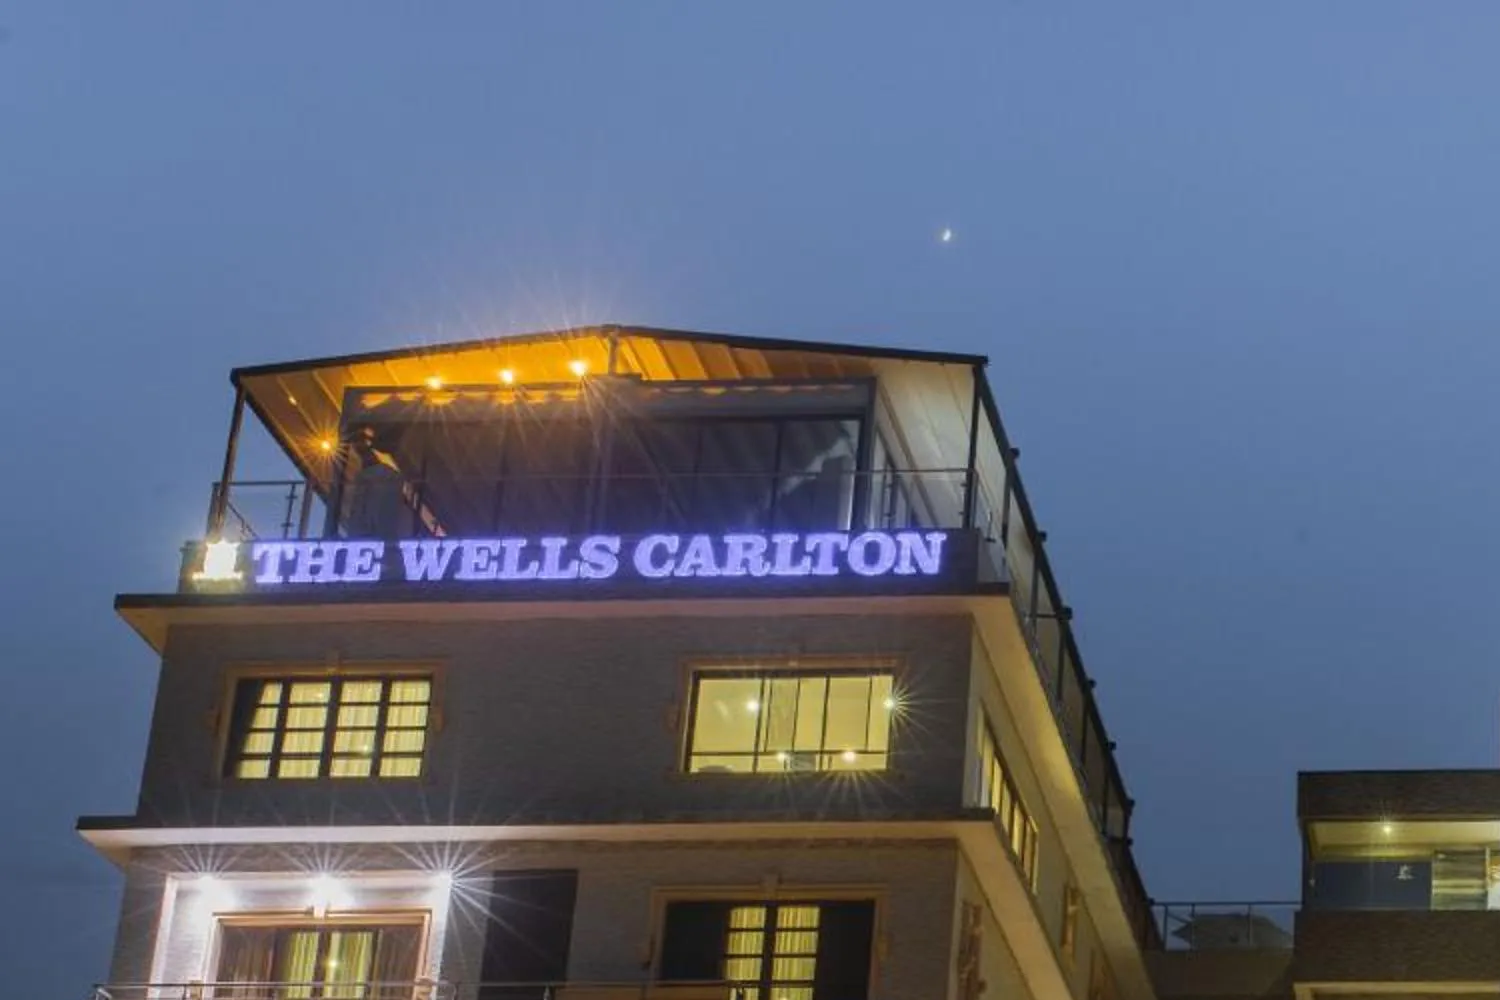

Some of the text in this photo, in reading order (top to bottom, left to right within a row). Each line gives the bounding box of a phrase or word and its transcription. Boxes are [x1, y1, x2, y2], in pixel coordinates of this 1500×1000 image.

[252, 531, 946, 584] THE WELLS CARLTON
